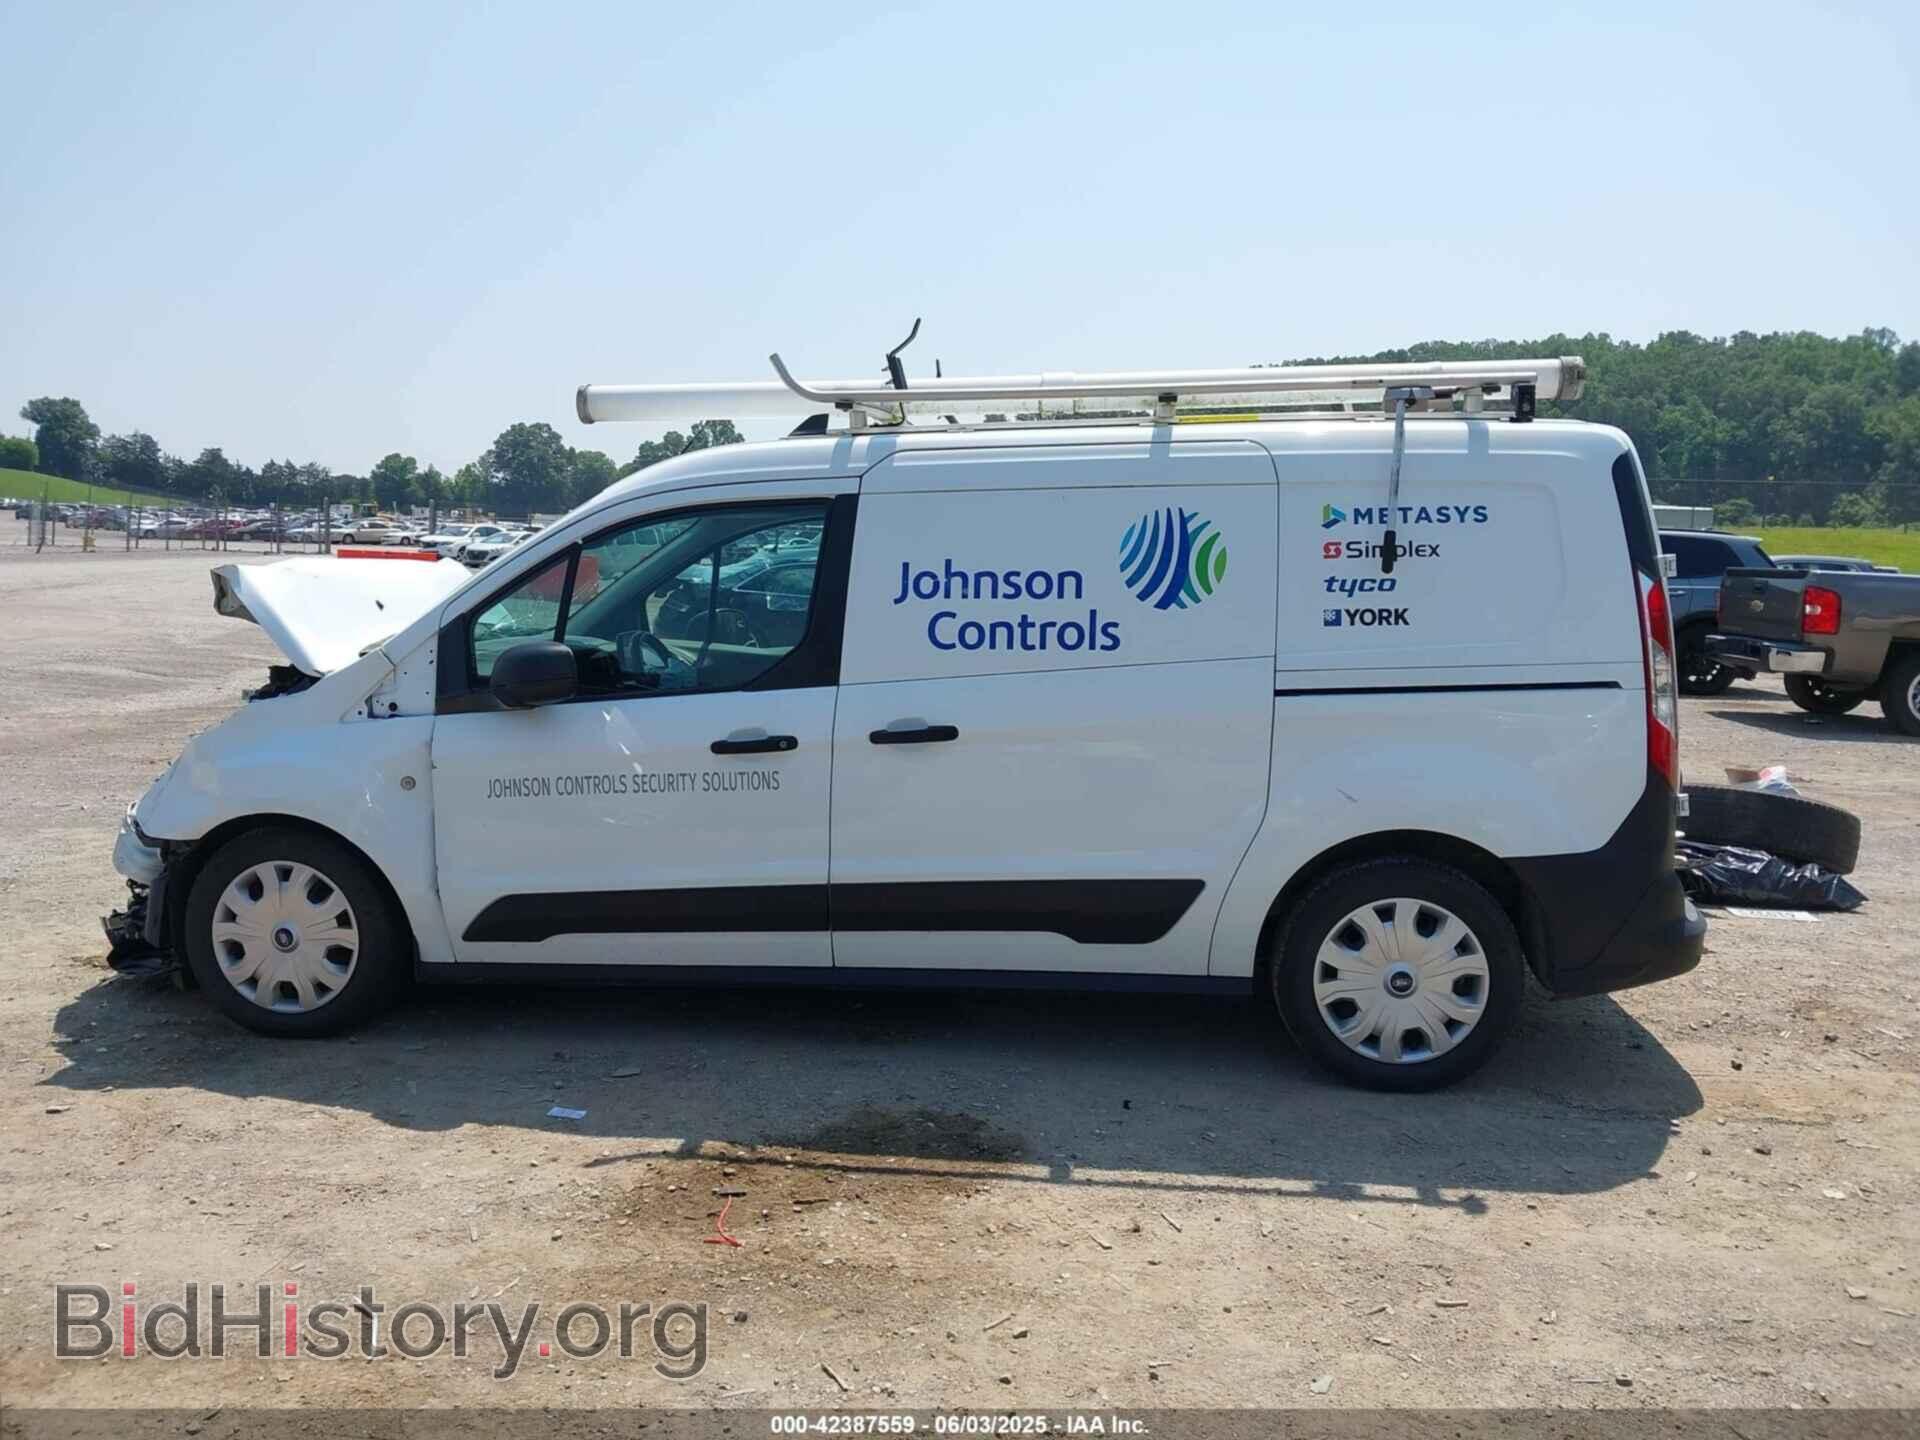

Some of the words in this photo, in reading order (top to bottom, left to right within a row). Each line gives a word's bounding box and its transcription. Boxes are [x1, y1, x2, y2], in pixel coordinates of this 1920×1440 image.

[1353, 506, 1488, 525] METASYS
[893, 558, 1083, 604] Johnson
[1323, 576, 1397, 598] tyco
[1344, 608, 1410, 626] YORK
[927, 609, 1121, 651] Controls
[487, 777, 550, 799] JOHNSON
[555, 774, 628, 796] CONTROLS
[632, 772, 698, 794] SECURITY
[702, 770, 780, 792] SOLUTIONS
